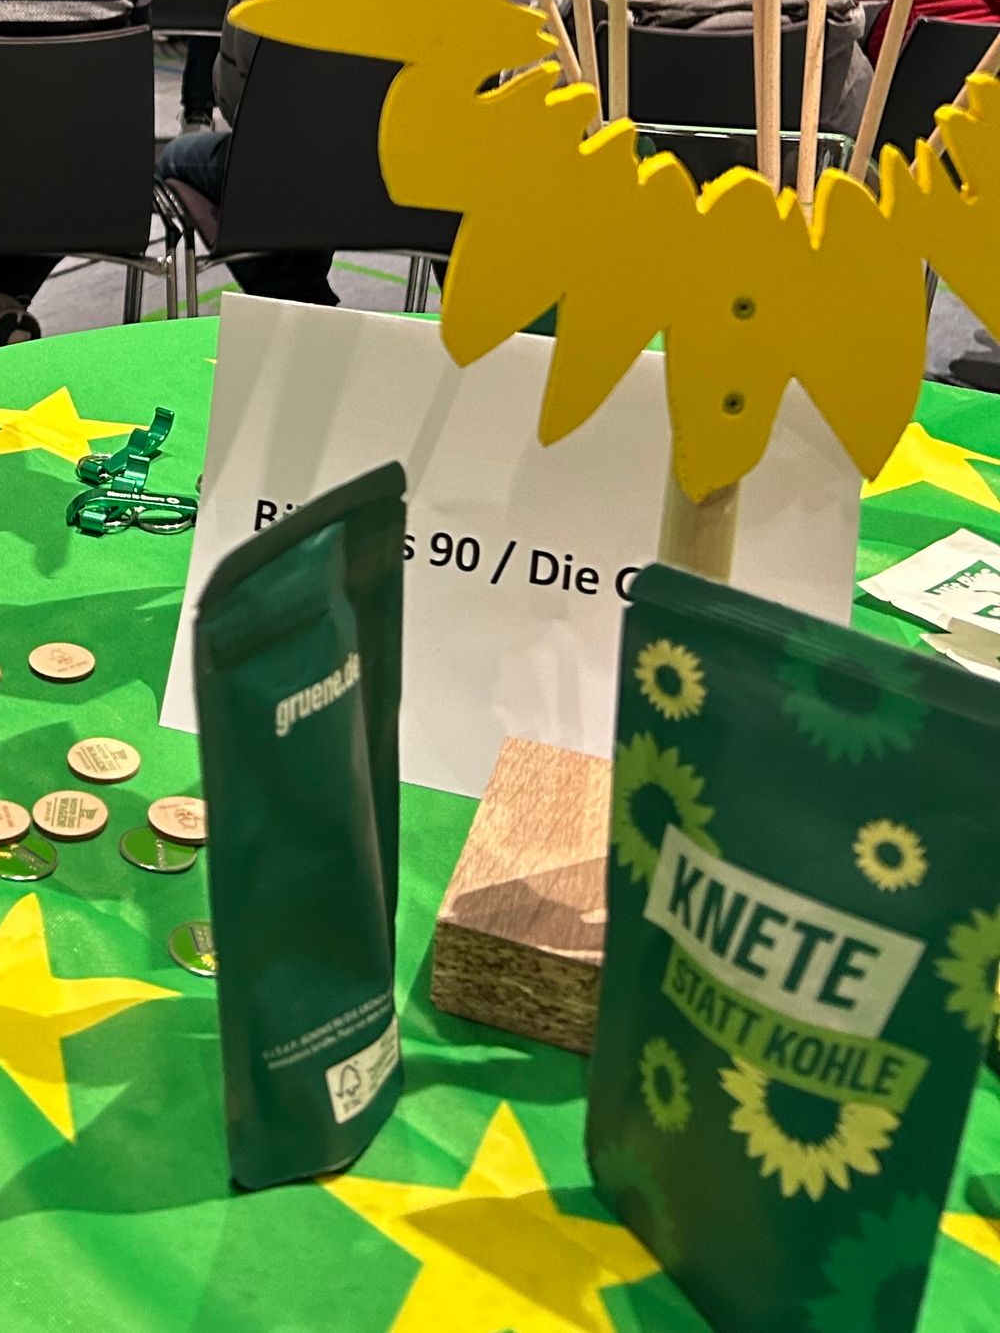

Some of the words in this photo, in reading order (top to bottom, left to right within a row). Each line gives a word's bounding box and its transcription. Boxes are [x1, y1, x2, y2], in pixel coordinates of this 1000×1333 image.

[429, 532, 480, 572] 90
[489, 540, 517, 585] /
[529, 549, 599, 595] Die
[276, 651, 361, 737] gruene.de
[668, 853, 881, 1011] KNETE
[671, 959, 762, 1046] STATT
[762, 1024, 905, 1096] KOHLE
